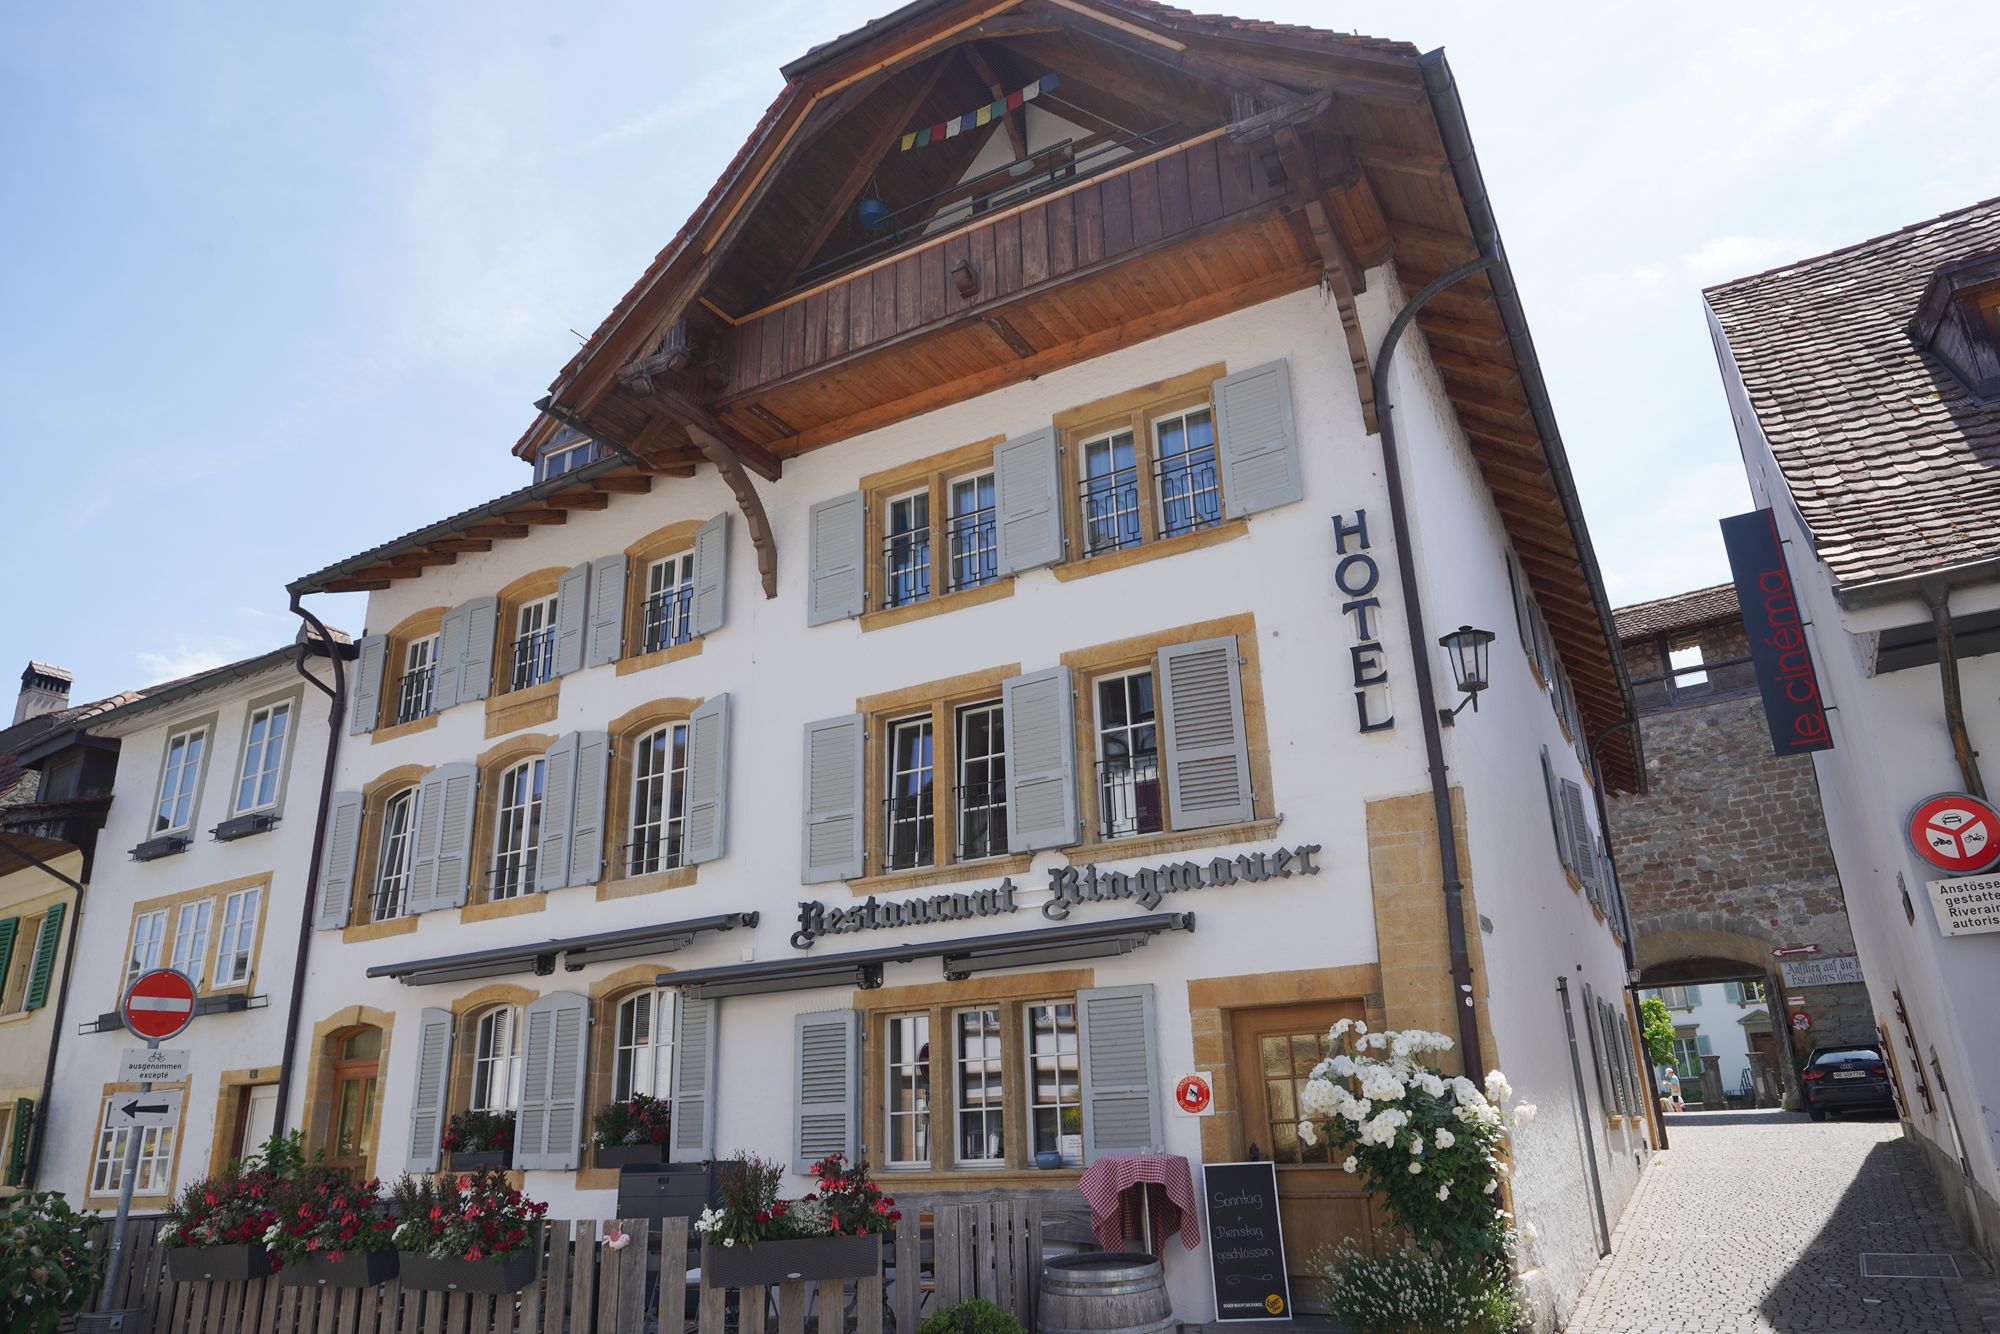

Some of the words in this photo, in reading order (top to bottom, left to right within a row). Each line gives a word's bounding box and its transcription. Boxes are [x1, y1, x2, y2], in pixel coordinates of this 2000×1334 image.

[1331, 509, 1394, 734] HOTEL
[1758, 567, 1816, 703] cinéma
[1791, 712, 1826, 746] le
[790, 876, 1019, 950] Restaurant
[1041, 843, 1322, 921] Ringmauer
[128, 1063, 182, 1071] ausgenommen
[139, 1071, 169, 1080] excepté
[1214, 1188, 1263, 1210] Sonntag
[1214, 1224, 1263, 1241] Dienstag
[1216, 1247, 1274, 1264] geschlossen
